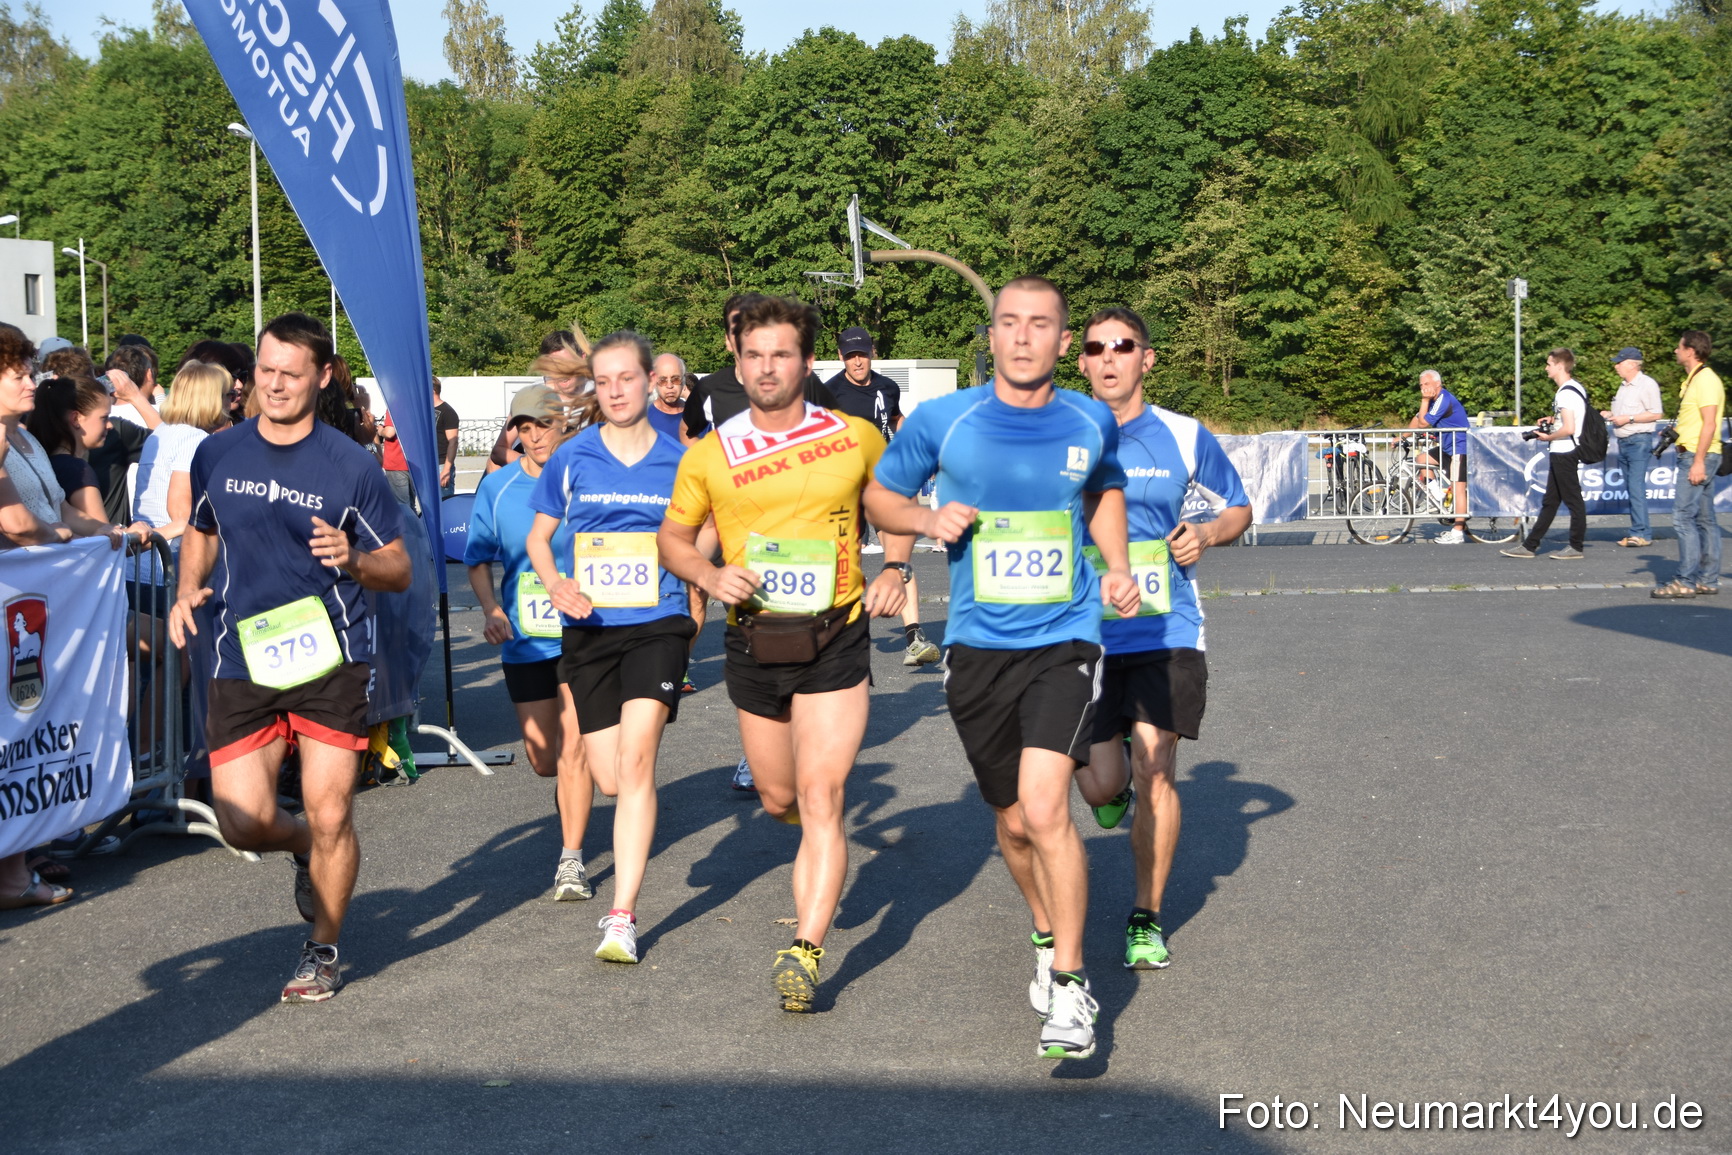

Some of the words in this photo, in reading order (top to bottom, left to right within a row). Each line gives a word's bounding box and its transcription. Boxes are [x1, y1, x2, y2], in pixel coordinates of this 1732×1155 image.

[732, 457, 792, 488] MAX
[797, 436, 859, 465] BÖGL
[1125, 465, 1171, 479] eladen
[225, 478, 268, 496] EURO
[280, 486, 324, 510] POLES
[579, 492, 671, 506] energiegeladen
[584, 563, 649, 586] 1328
[984, 548, 1063, 578] 1282
[762, 569, 816, 597] 898
[527, 599, 563, 620] 12
[264, 632, 318, 669] 379
[16, 682, 37, 701] 1628
[0, 720, 79, 770] umarkter
